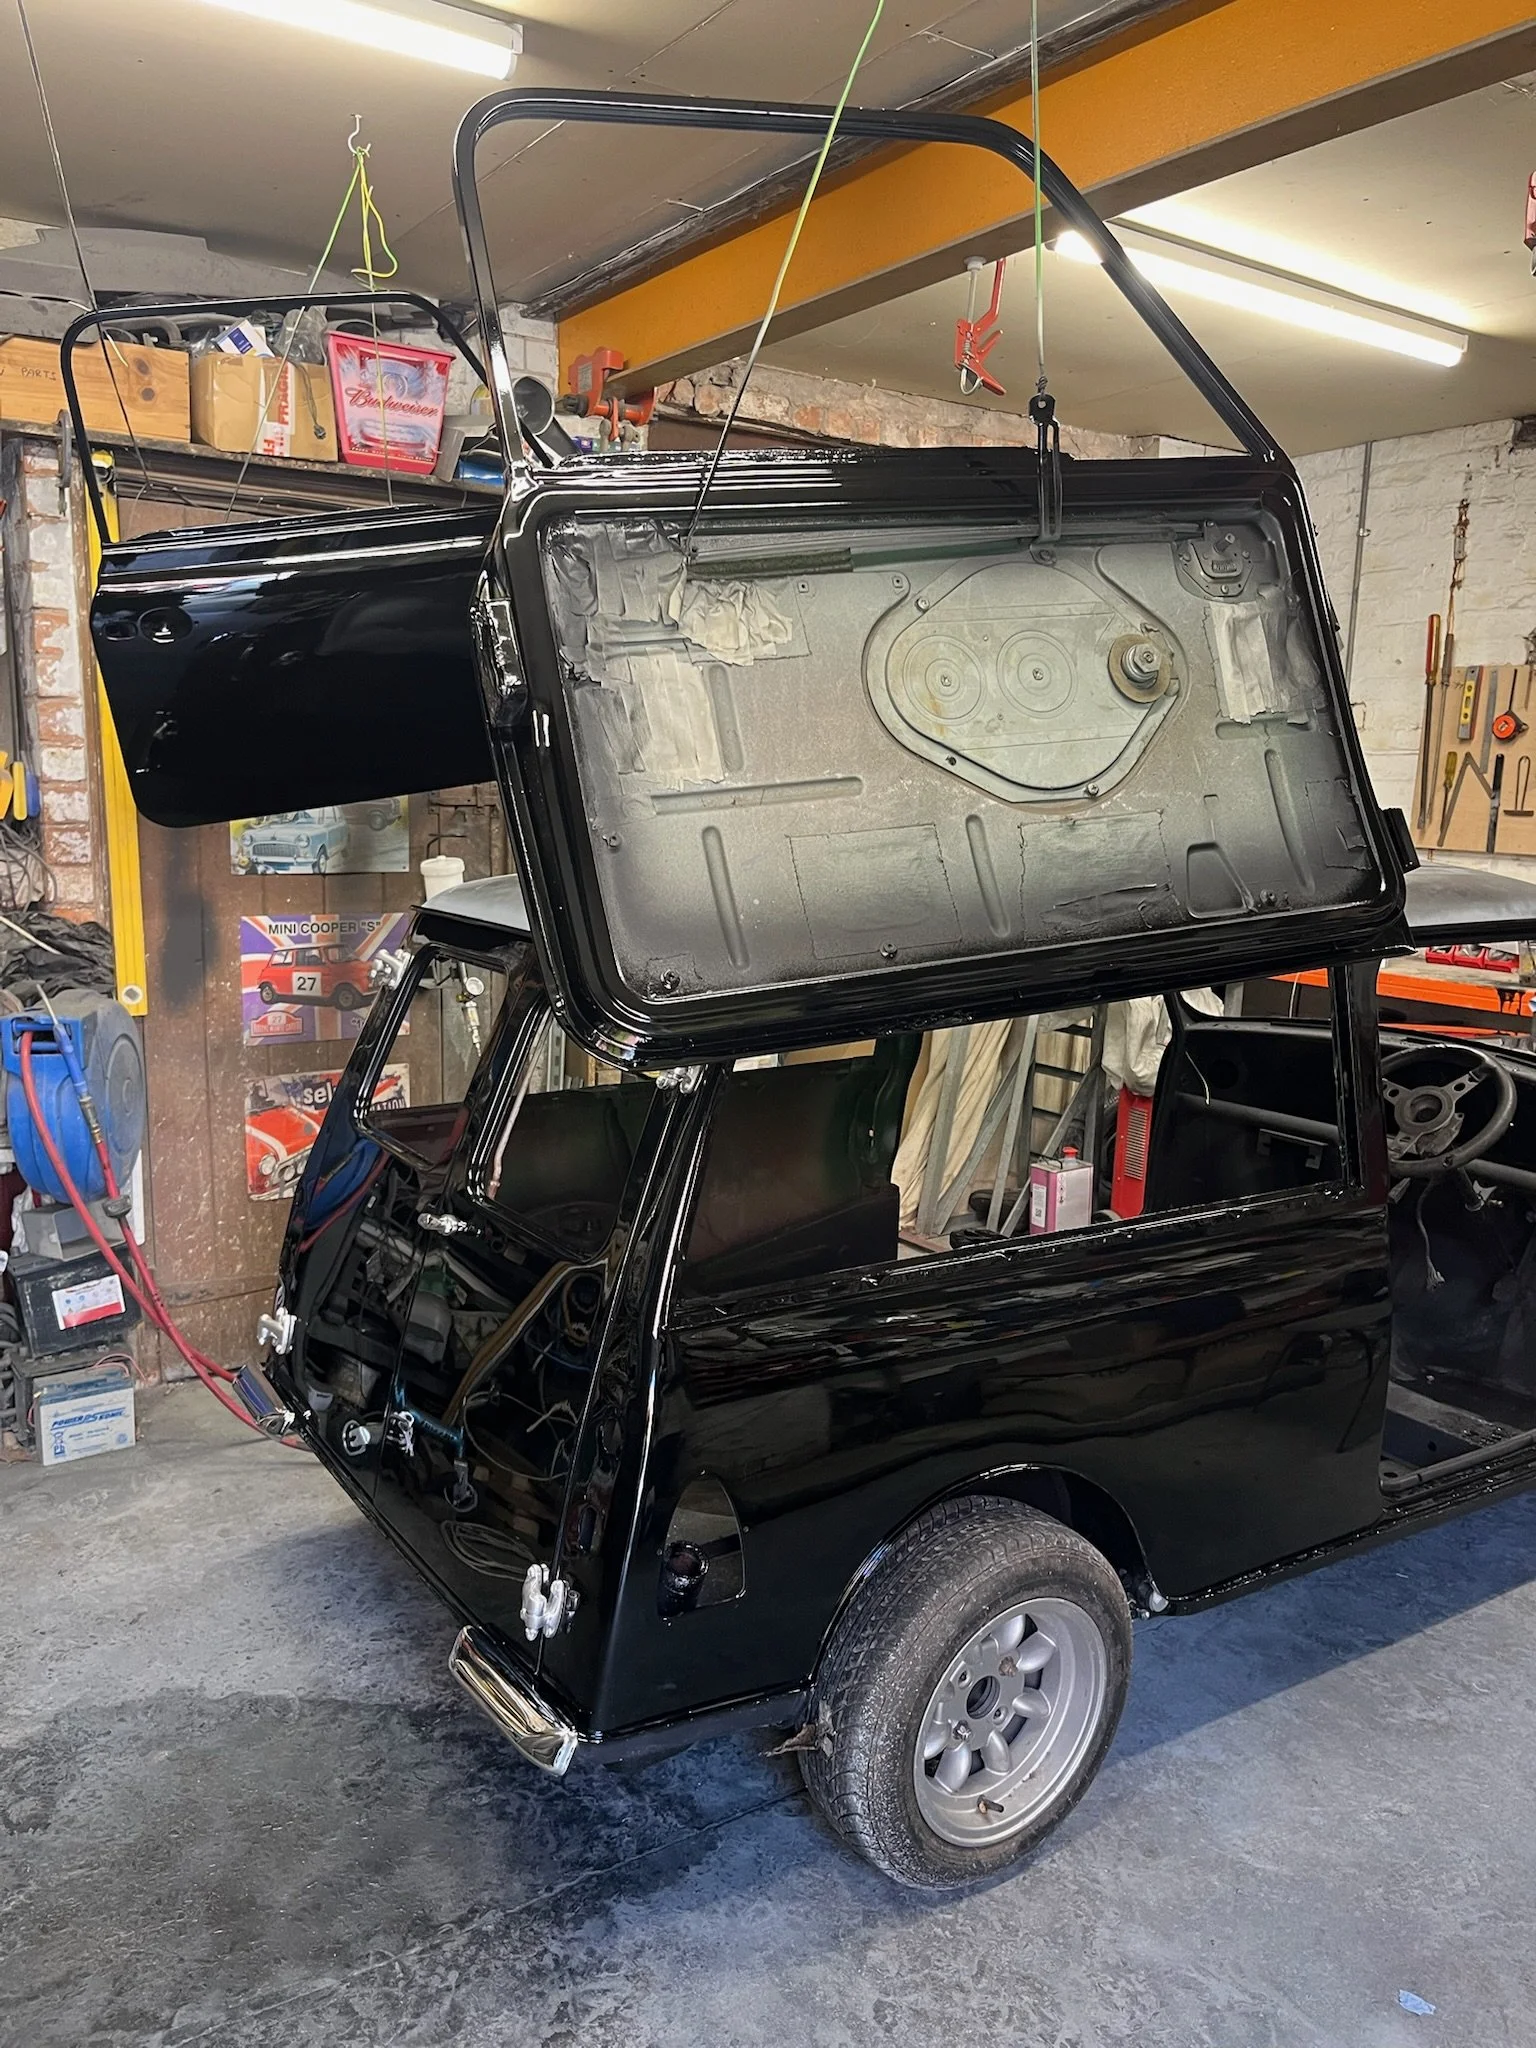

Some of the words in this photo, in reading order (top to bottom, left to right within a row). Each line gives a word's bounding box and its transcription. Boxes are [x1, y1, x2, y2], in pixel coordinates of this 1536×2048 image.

[21, 367, 56, 381] PARTS
[345, 385, 438, 417] Budweiser
[268, 924, 297, 934] MINI
[301, 921, 357, 934] COOPER
[361, 921, 381, 932] "S"
[297, 976, 316, 991] 27
